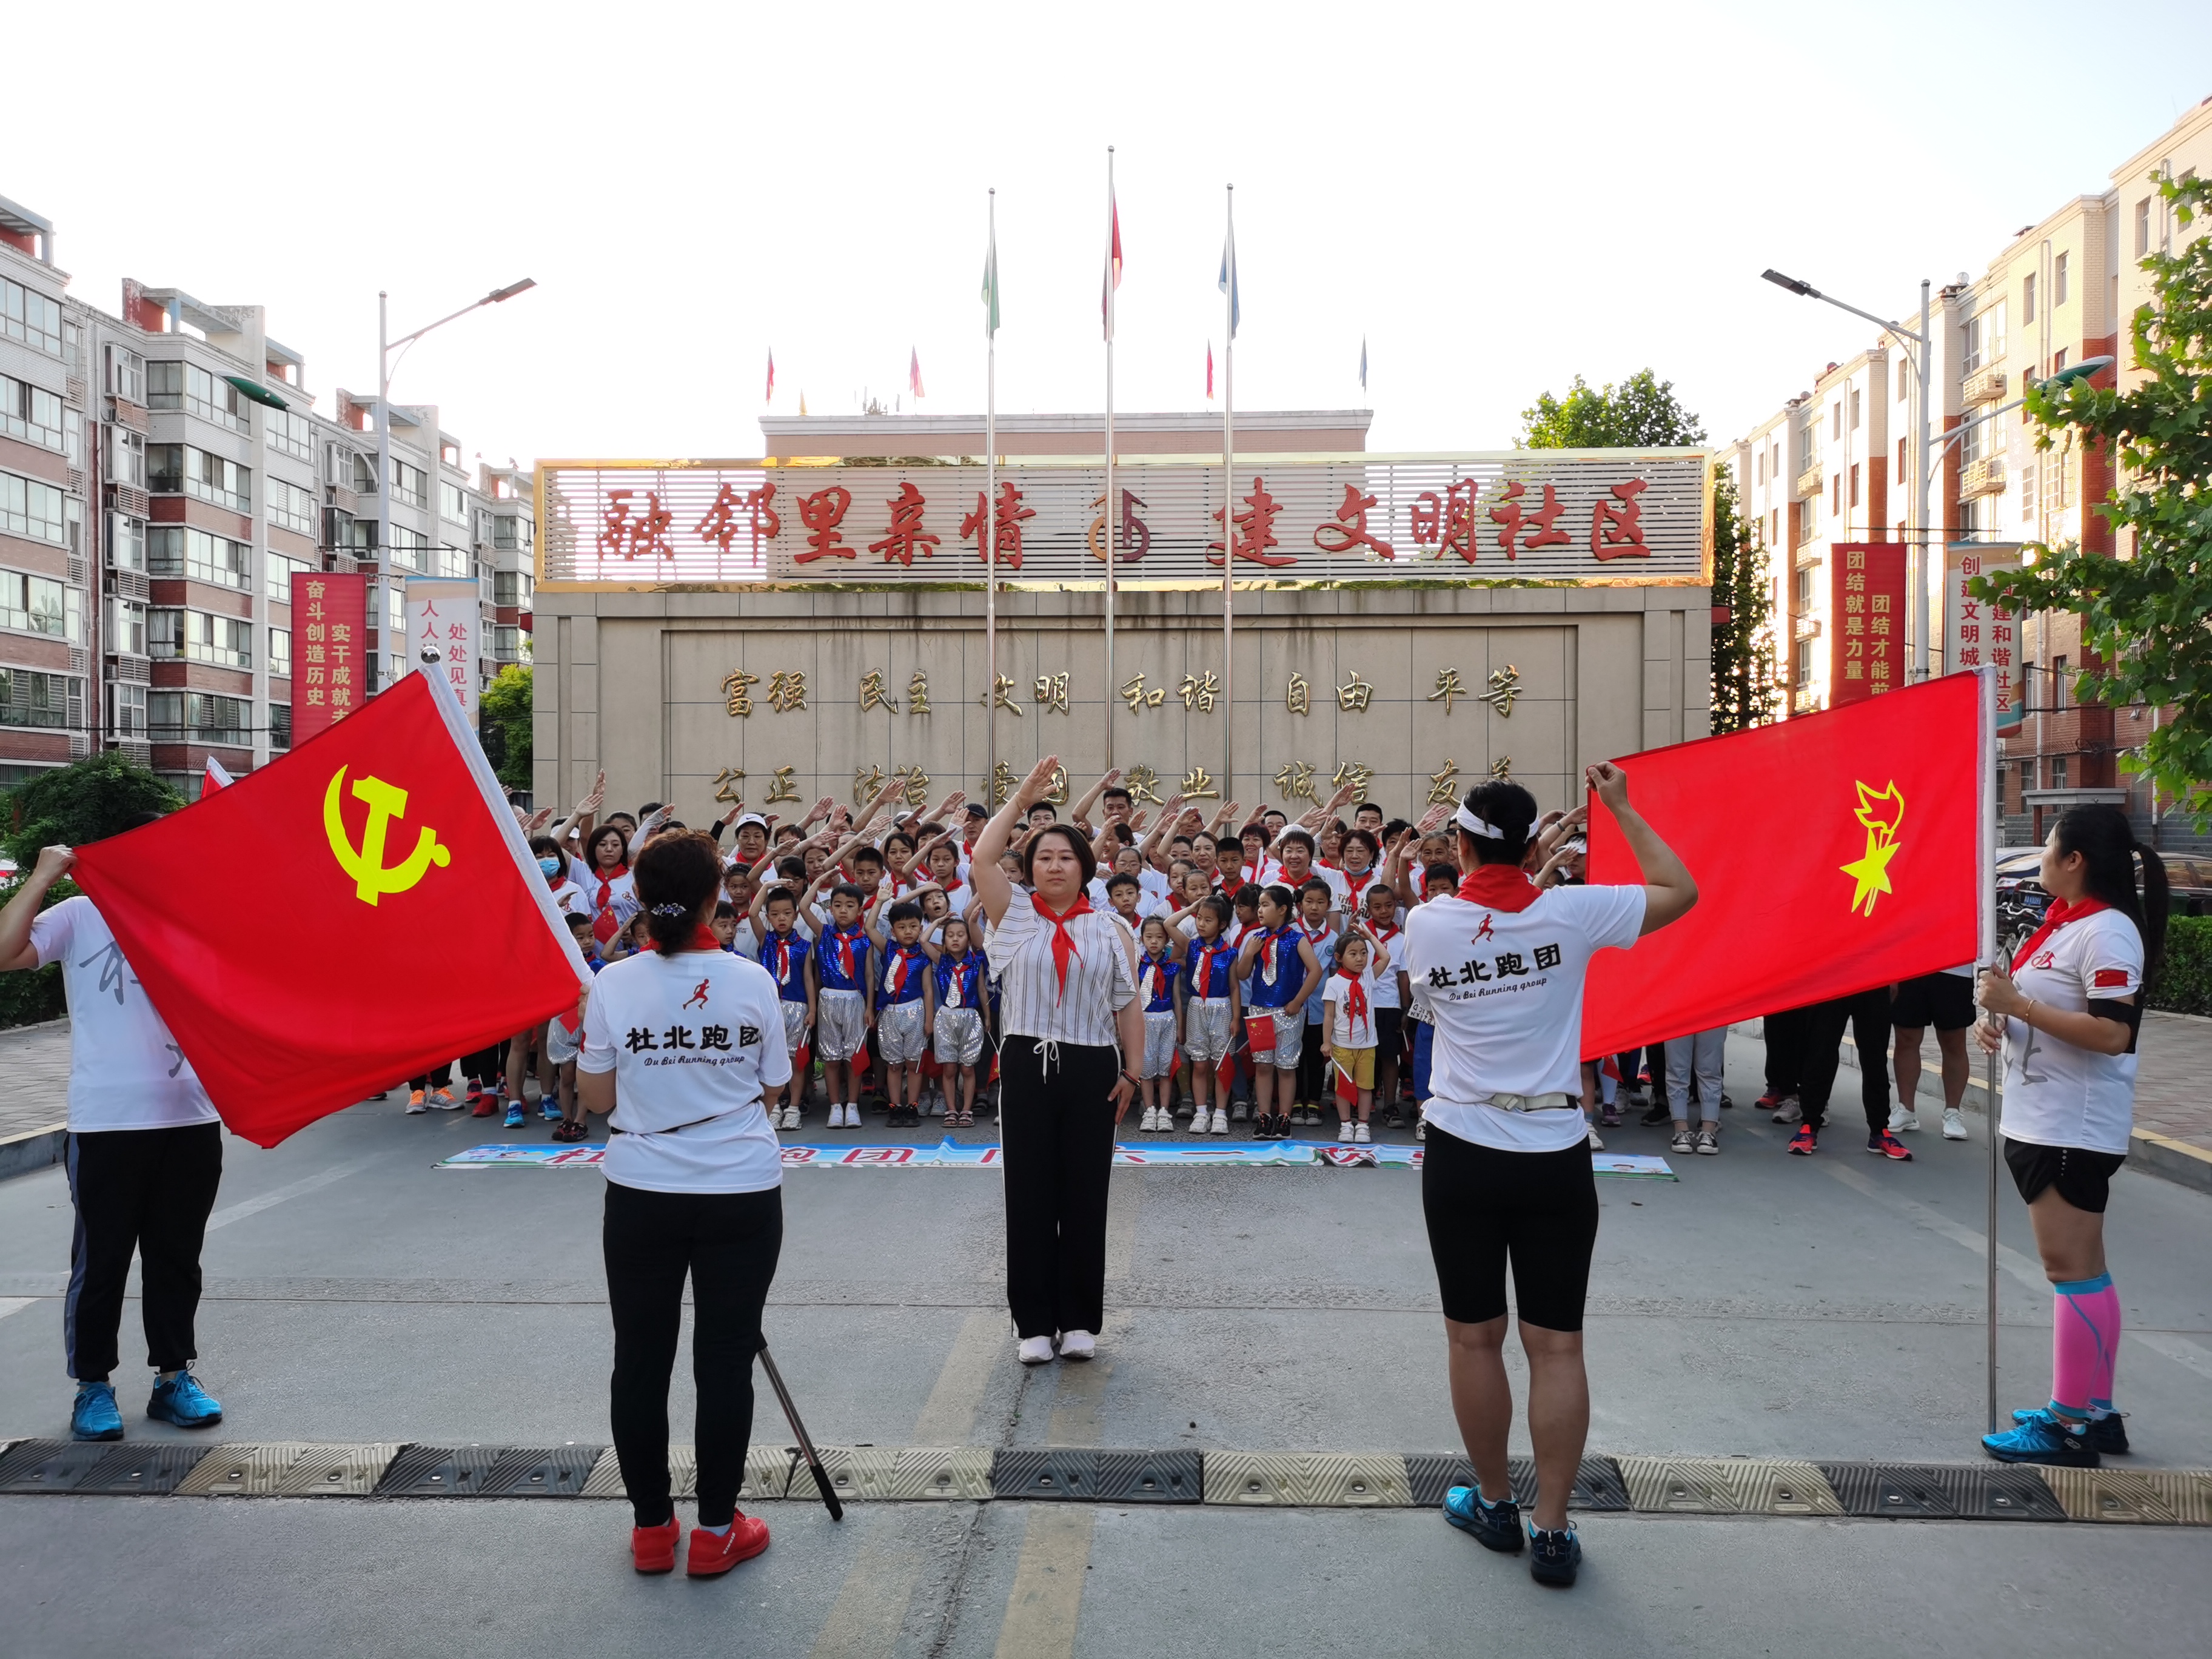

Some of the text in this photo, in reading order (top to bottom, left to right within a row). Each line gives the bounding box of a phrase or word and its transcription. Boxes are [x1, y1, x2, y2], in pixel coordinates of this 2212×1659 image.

[595, 476, 1651, 569] 融邻里亲情 建文明社区
[420, 599, 440, 651] 人人
[1844, 551, 1866, 679] 团结就是力量
[306, 580, 326, 706] 奋斗创造历史
[1991, 581, 2013, 712] 建和谐社区
[720, 664, 1523, 719] 富强 民主 文明 和谐 自由 平等
[712, 765, 803, 804] 公正
[853, 763, 930, 806] 法治
[1124, 763, 1220, 806] 敬业
[1273, 760, 1374, 808] 诚信
[1428, 943, 1561, 989] 杜北跑团
[1449, 977, 1547, 1001] Du Bei Running group
[625, 1024, 760, 1054] 杜北跑团
[644, 1055, 745, 1067] Du Bei Running group
